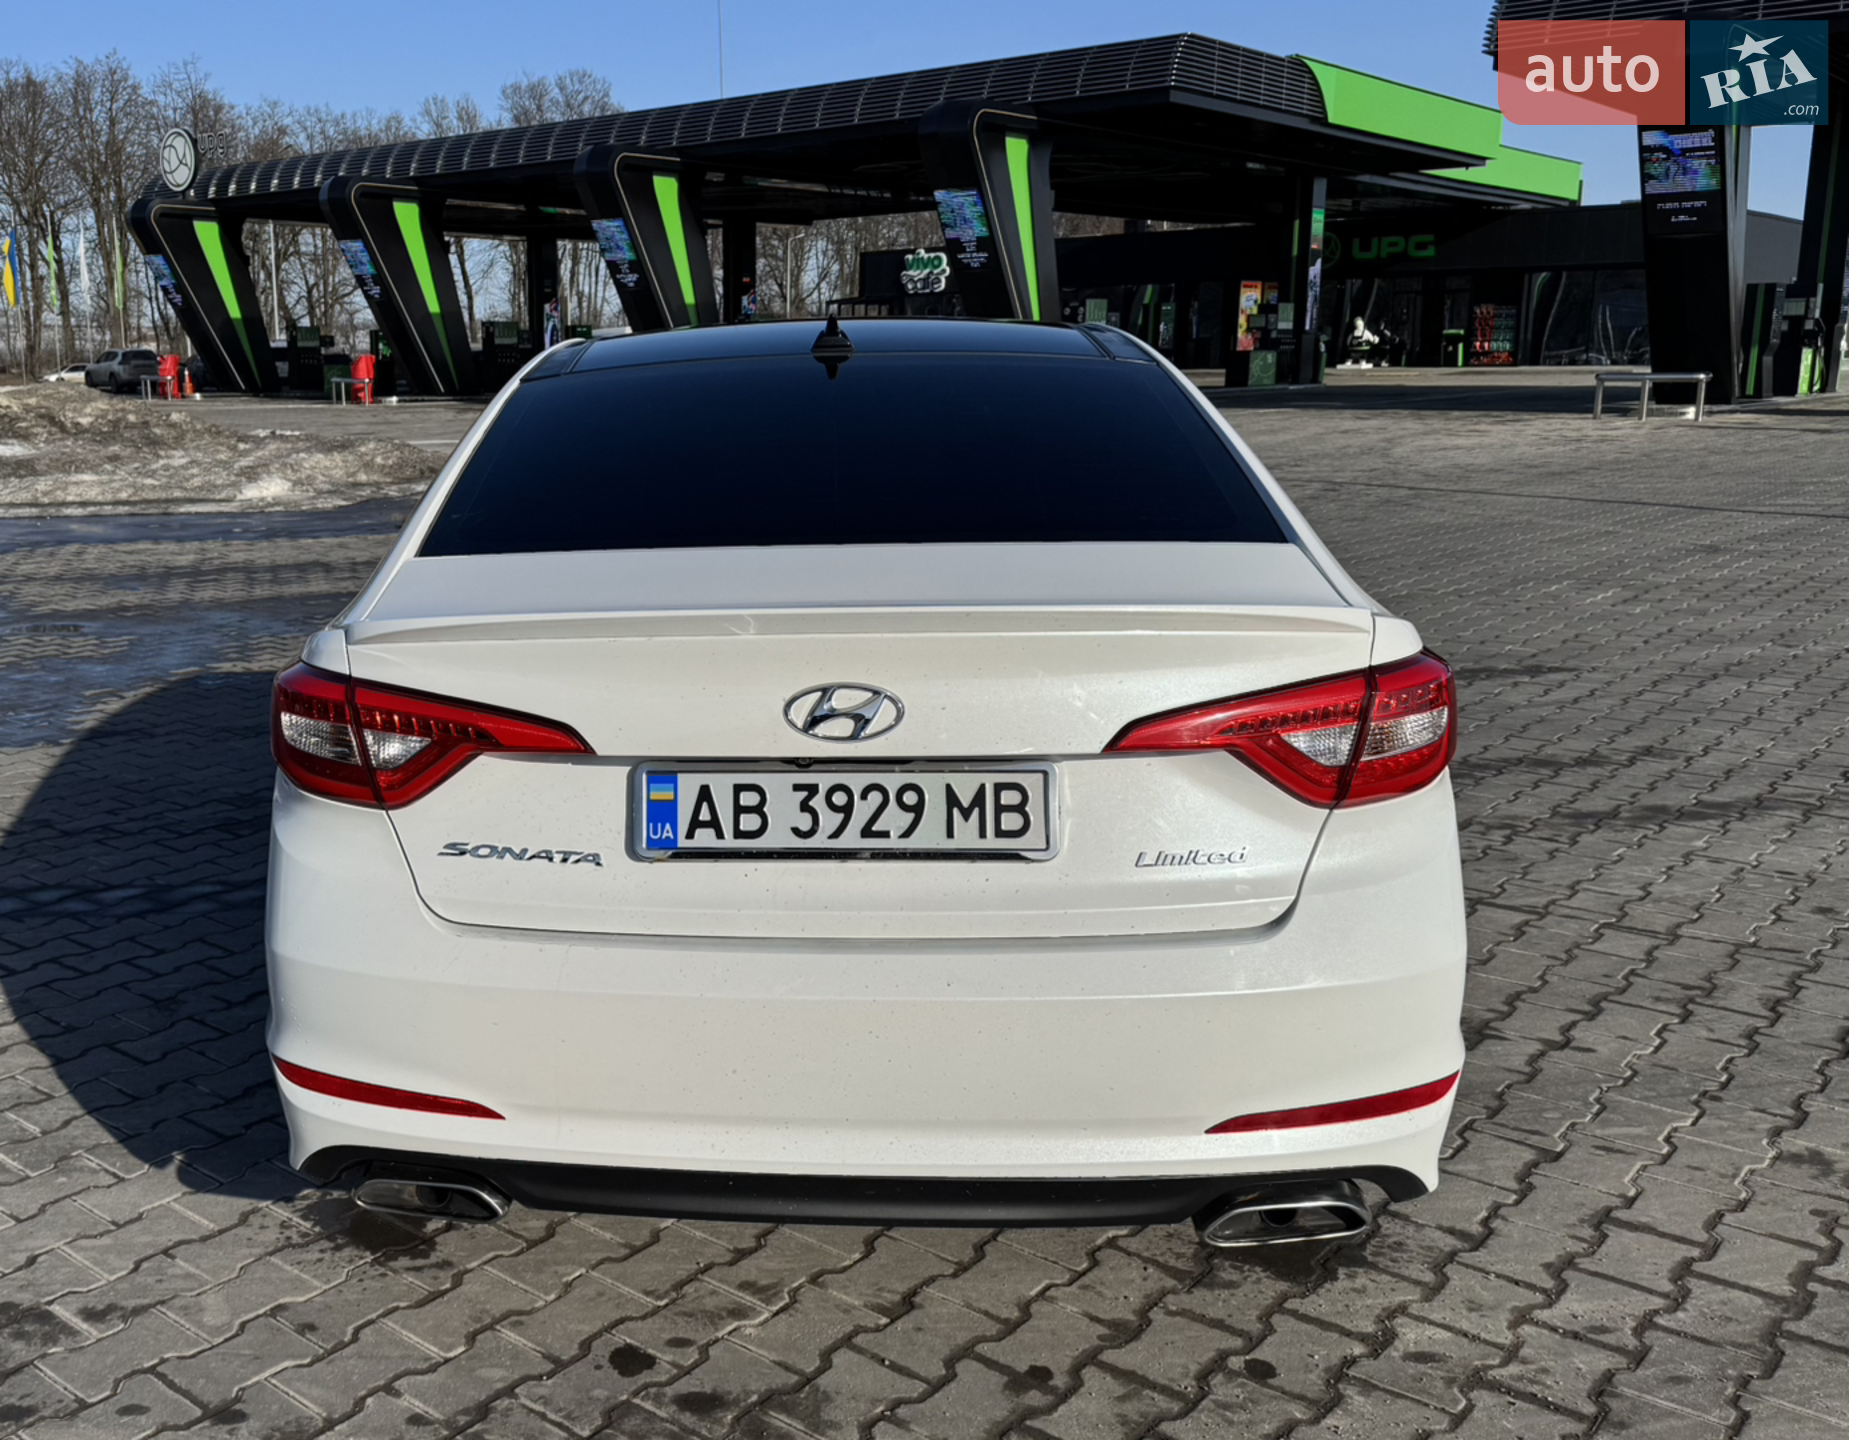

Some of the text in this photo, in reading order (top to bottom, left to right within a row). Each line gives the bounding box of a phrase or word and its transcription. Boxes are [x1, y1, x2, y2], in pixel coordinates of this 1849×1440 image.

[1352, 234, 1436, 260] UPG
[684, 782, 1033, 841] AB 3929 MB
[649, 822, 675, 840] UA
[436, 841, 604, 868] SONATA
[1134, 846, 1248, 868] Limited
